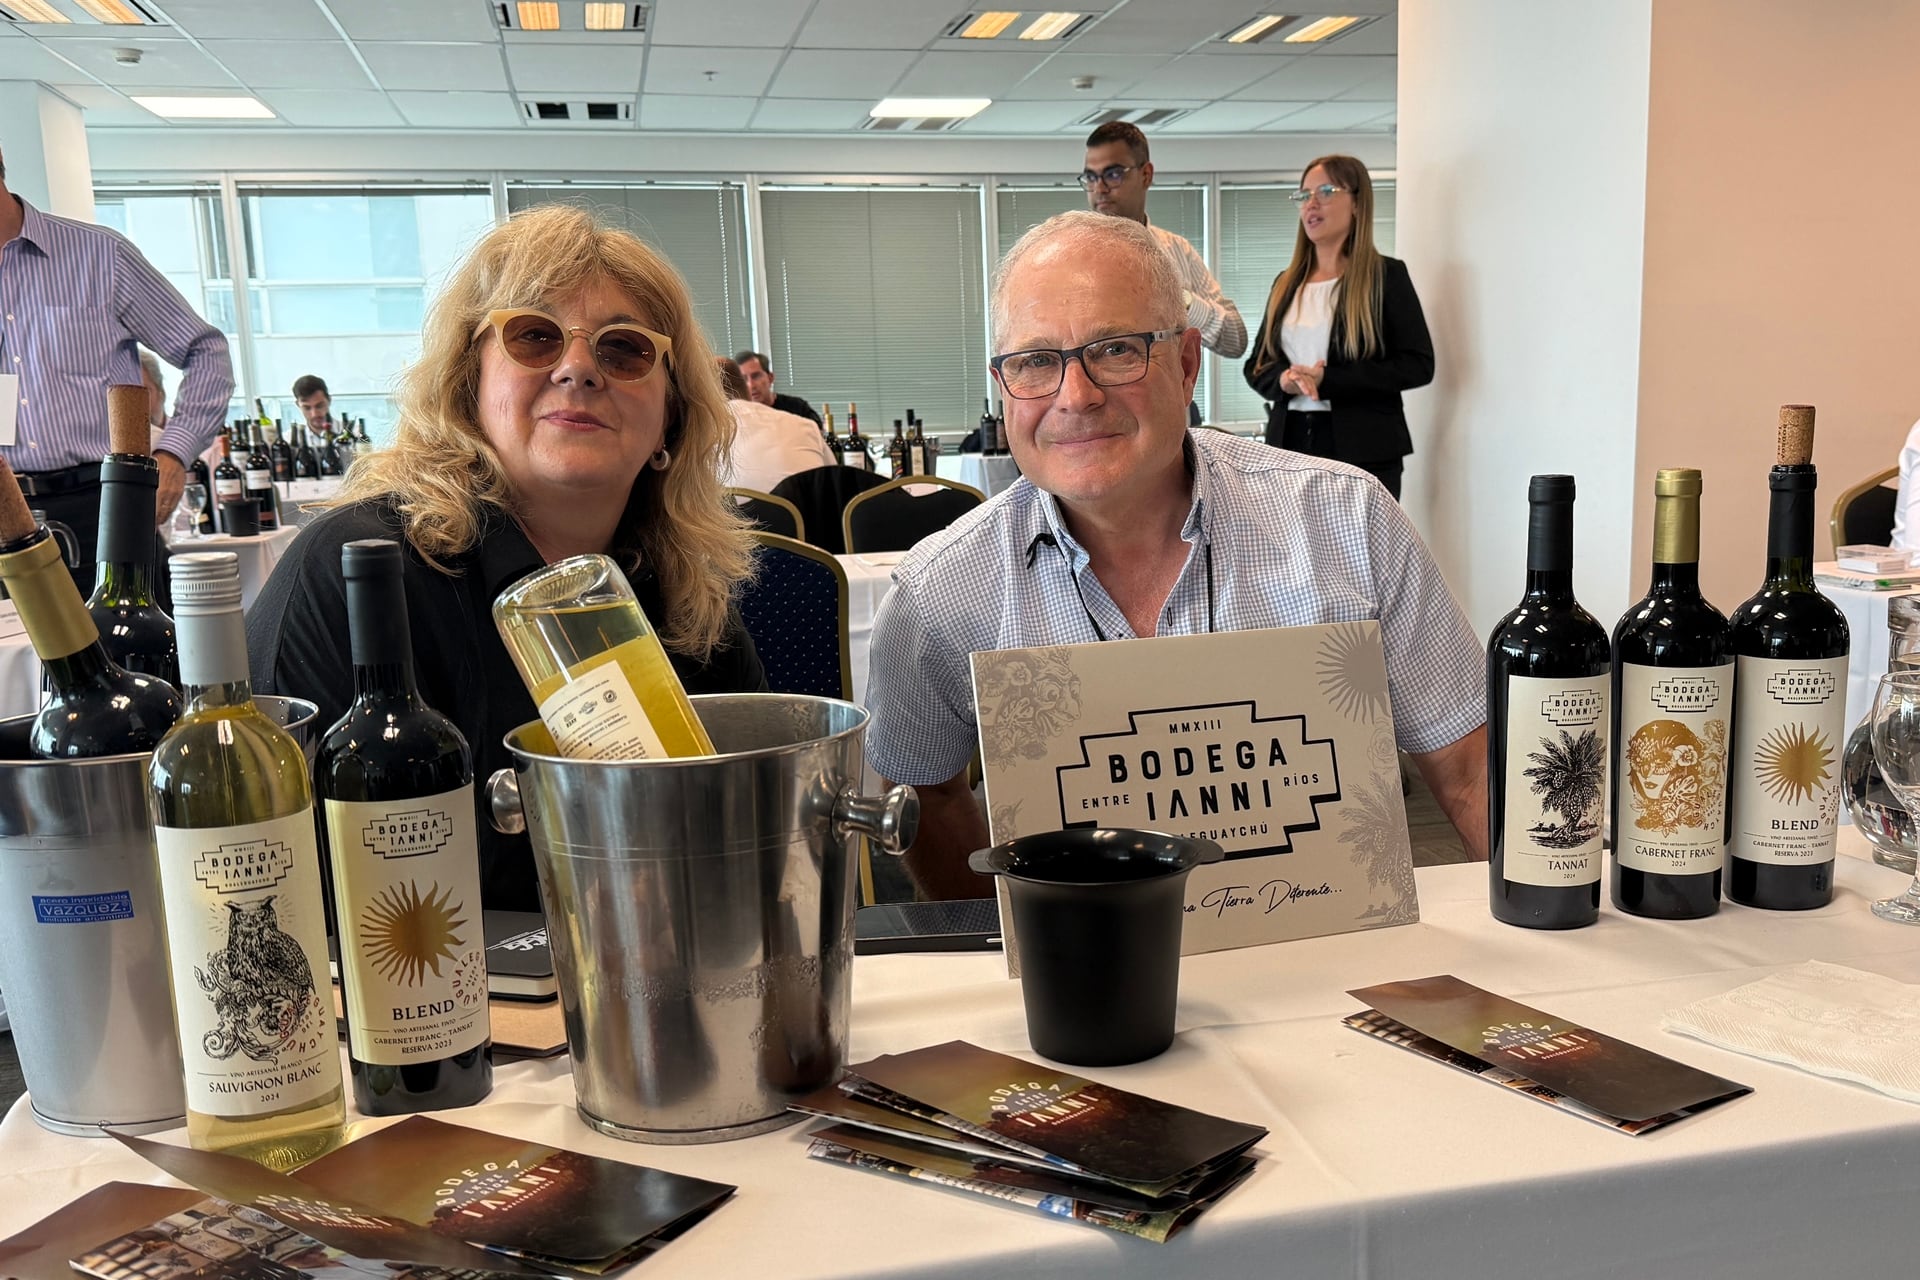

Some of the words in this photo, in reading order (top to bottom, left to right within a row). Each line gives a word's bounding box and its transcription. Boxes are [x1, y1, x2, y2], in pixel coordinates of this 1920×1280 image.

[1781, 677, 1826, 686] BODEGA
[1665, 685, 1710, 694] BODEGA
[1789, 687, 1821, 695] IANNI
[1555, 697, 1596, 707] BODEGA
[1672, 694, 1705, 703] IANNI
[1563, 707, 1592, 716] IANNI
[1169, 719, 1222, 734] MMXIII
[1108, 738, 1288, 784] BODEGA
[1283, 772, 1320, 787] RÍOS
[1082, 794, 1130, 809] ENTRE
[1146, 779, 1272, 821] IANNI
[379, 819, 439, 835] BODEGA
[1180, 821, 1269, 841] EGUAYCHÚ
[1771, 819, 1819, 831] BLEND
[391, 832, 433, 846] IANNI
[1753, 840, 1785, 849] CABERNET
[211, 850, 278, 868] BODEGA
[1635, 845, 1686, 859] CABERNET
[1689, 846, 1716, 859] FRANC
[225, 864, 271, 879] IANNI
[1548, 858, 1589, 871] TANNAT
[71, 894, 128, 904] inoxidable
[1201, 885, 1255, 918] Tierra
[392, 999, 455, 1021] BLEND
[374, 1037, 413, 1045] CABERNET
[415, 1032, 441, 1043] FRANC
[449, 1022, 474, 1036] TANNAT
[409, 1023, 439, 1034] ARTESANAL
[441, 1018, 456, 1027] TINTO
[1482, 1022, 1552, 1044] BODEGA
[402, 1045, 433, 1054] RESERVA
[435, 1039, 452, 1050] 2023
[1506, 1034, 1589, 1060] IANNI
[246, 1066, 279, 1076] ARTESANAL
[281, 1060, 303, 1071] BLANCO
[209, 1075, 284, 1093] SAUVIGNON
[287, 1062, 322, 1084] BLANC
[989, 1082, 1061, 1111] BODEGA
[1016, 1093, 1099, 1127] IANNI
[435, 1159, 520, 1207] BODEGA
[461, 1166, 560, 1218] IANNI
